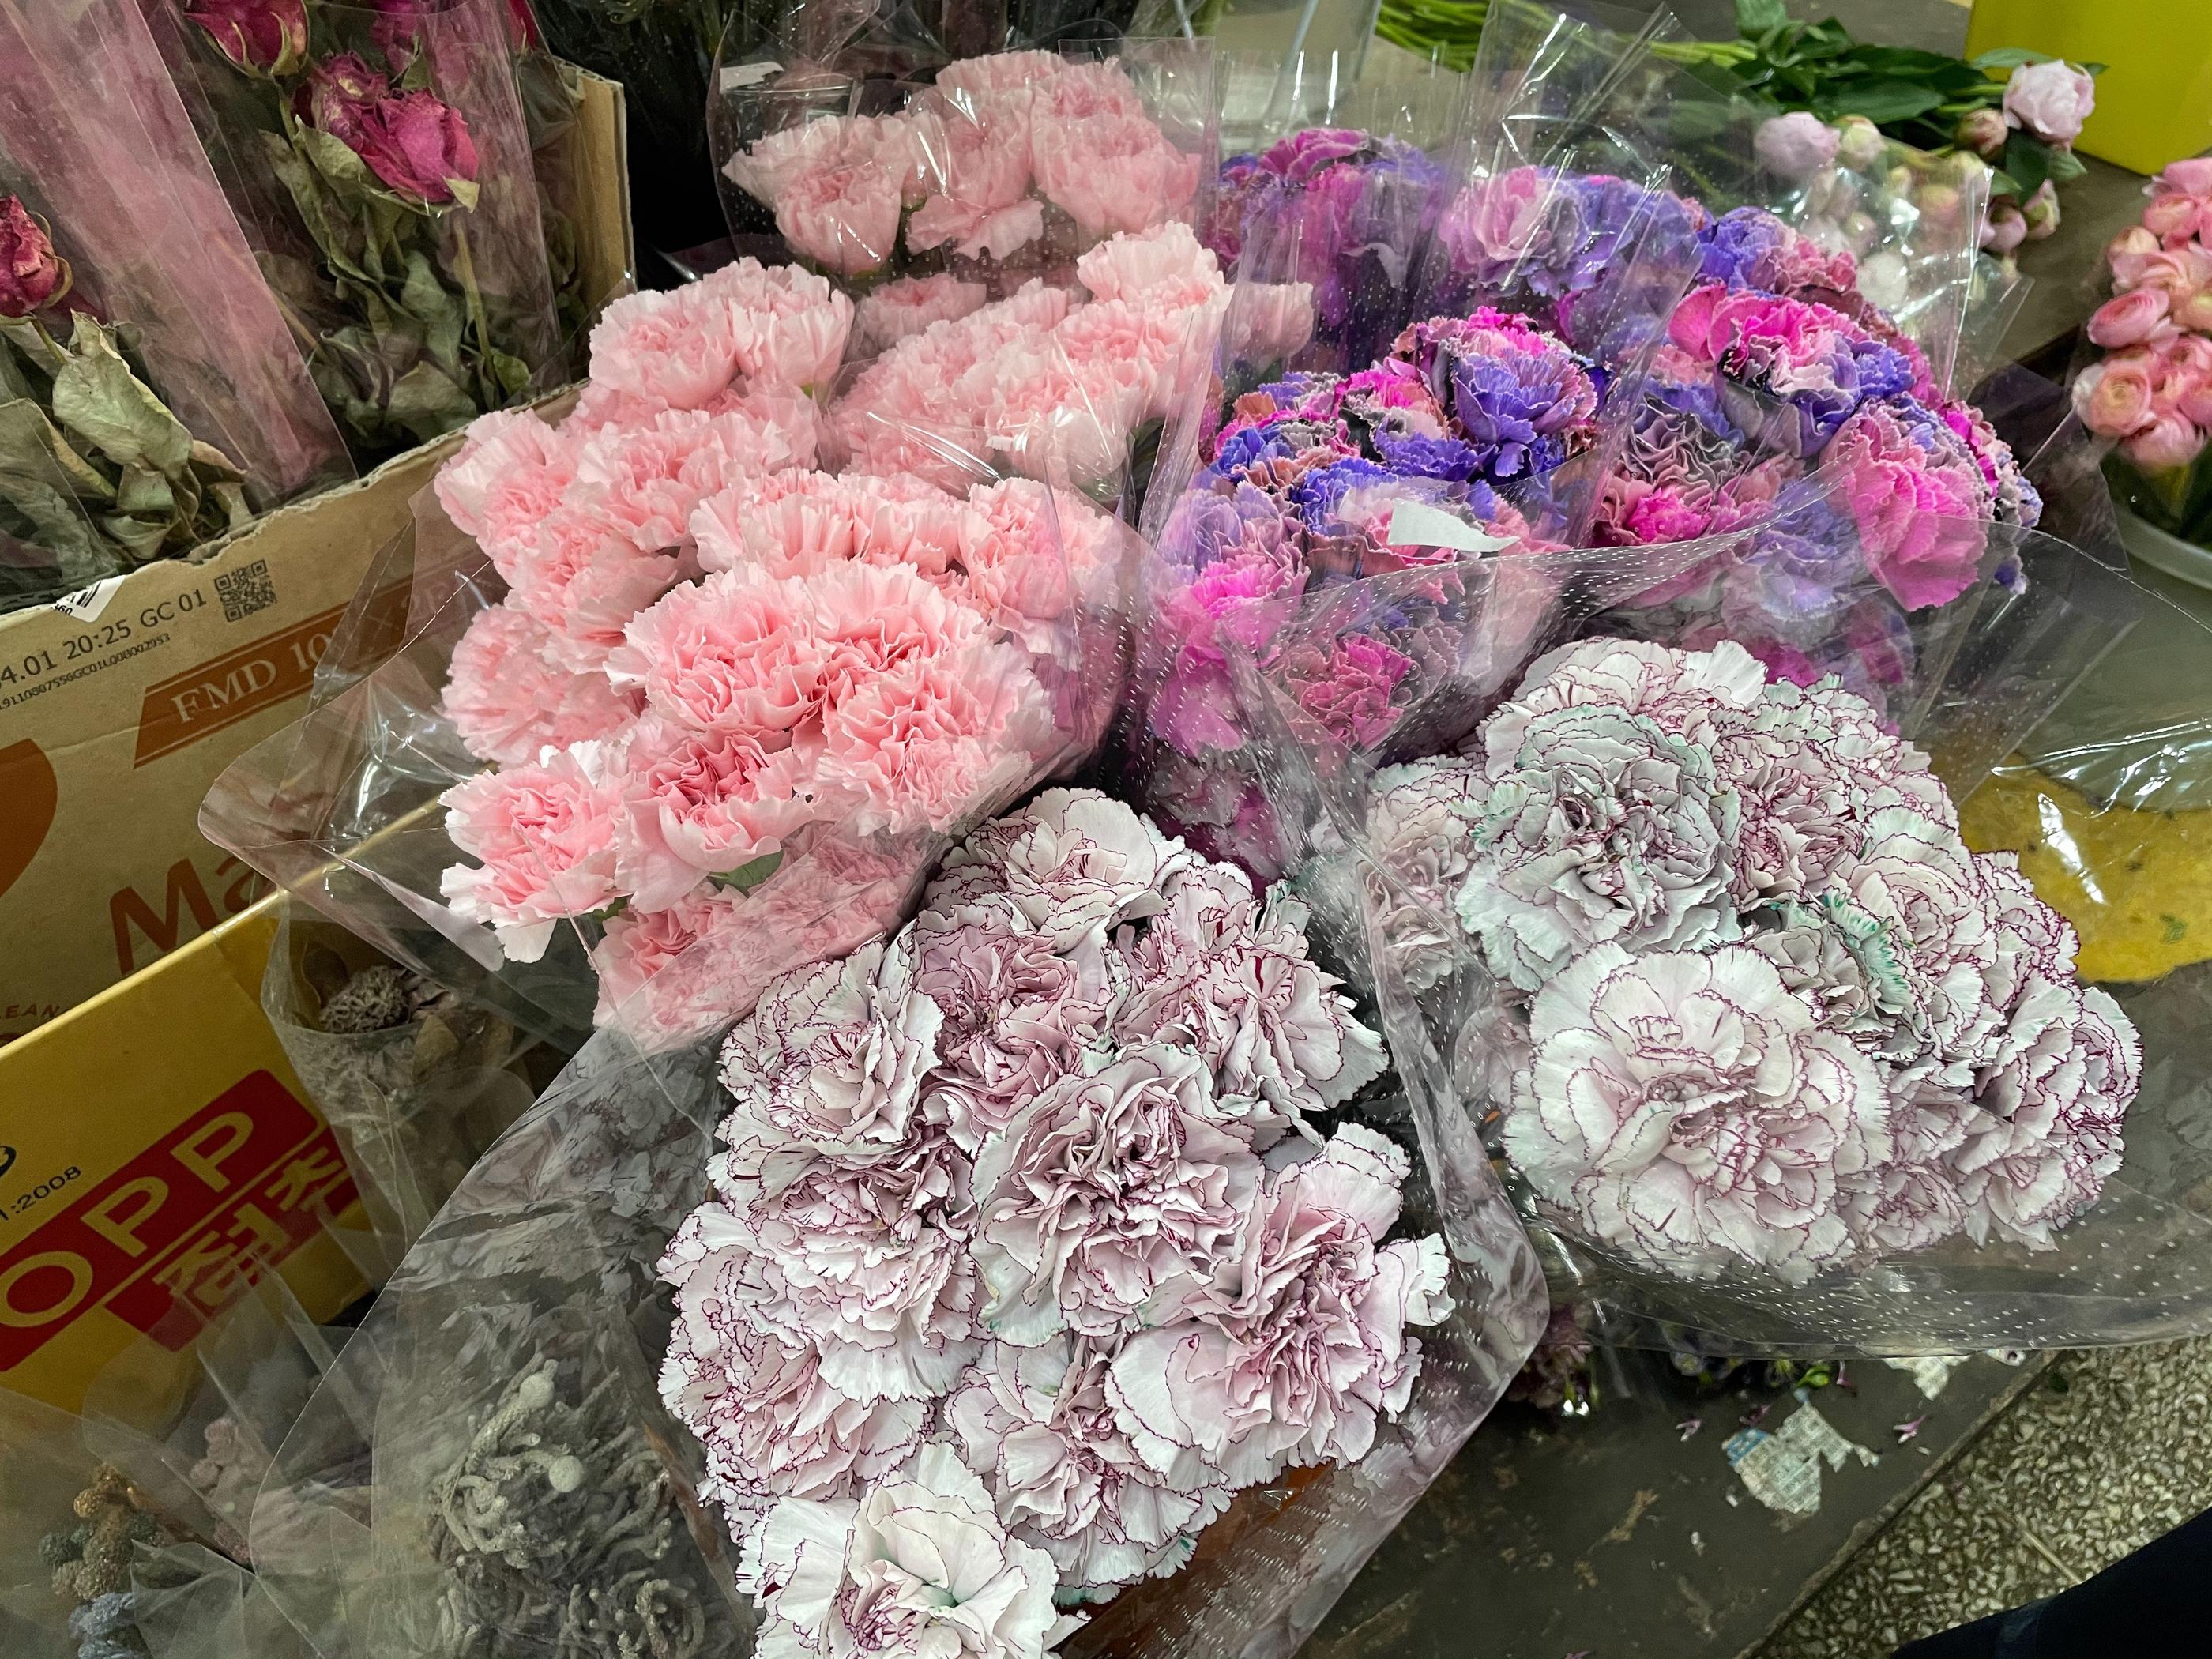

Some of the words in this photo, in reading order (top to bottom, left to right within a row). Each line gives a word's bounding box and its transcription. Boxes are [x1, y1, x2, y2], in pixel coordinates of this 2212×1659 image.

[0, 649, 58, 689] 4.01
[62, 619, 132, 660] 20:25
[140, 601, 175, 627] GC
[178, 589, 207, 612] 01
[171, 658, 276, 723] FMD
[0, 1003, 60, 1019] EAN
[0, 1112, 254, 1328] OPP
